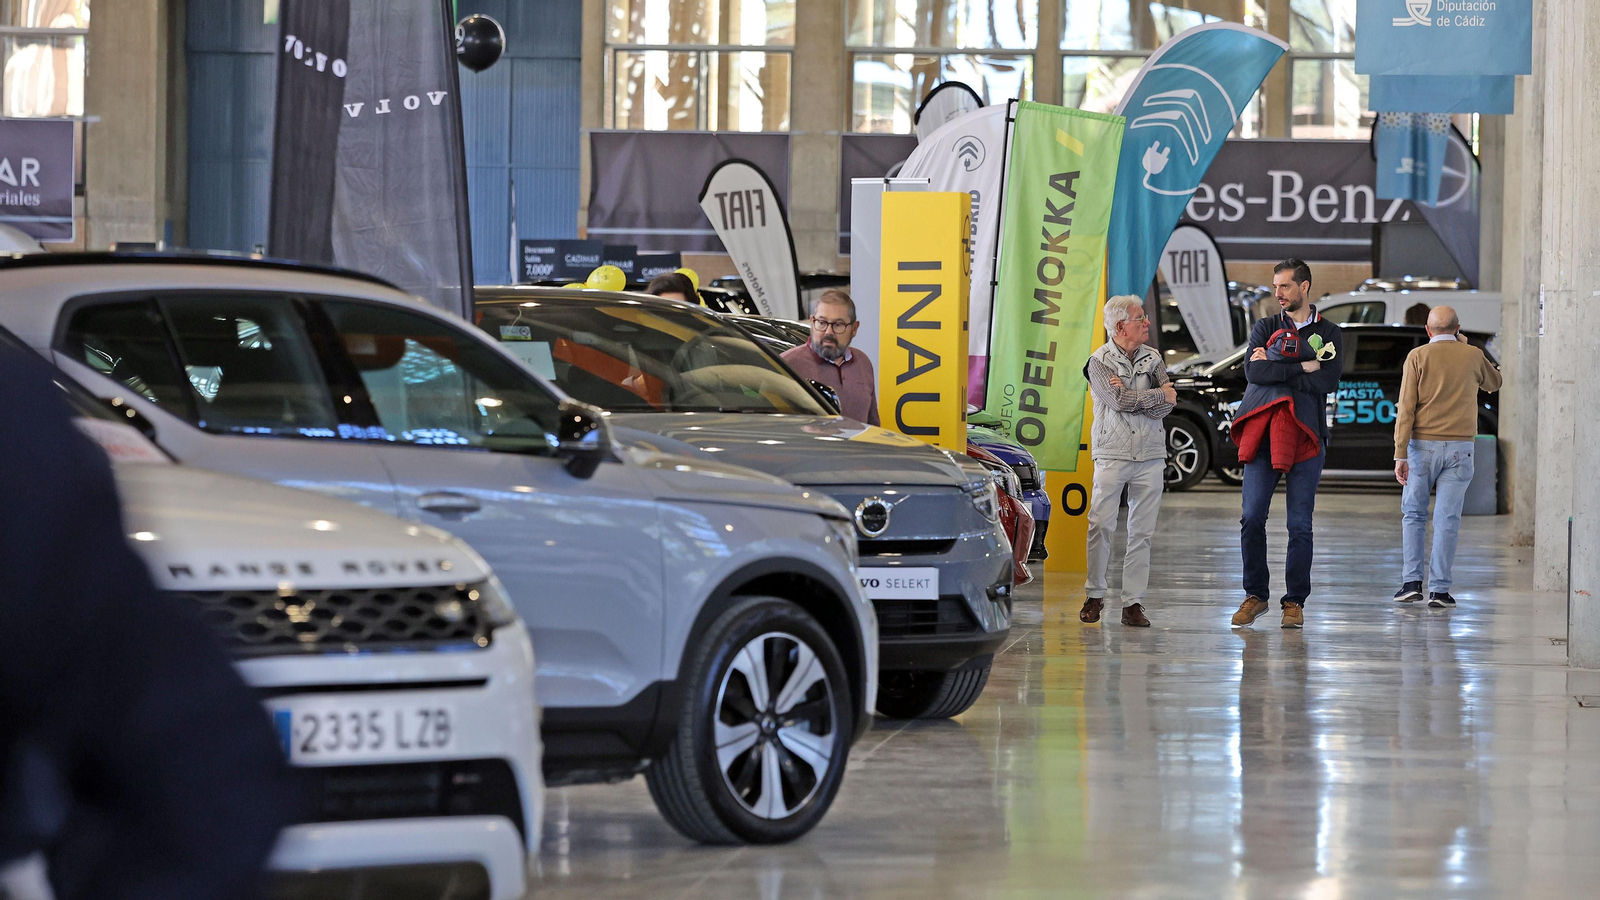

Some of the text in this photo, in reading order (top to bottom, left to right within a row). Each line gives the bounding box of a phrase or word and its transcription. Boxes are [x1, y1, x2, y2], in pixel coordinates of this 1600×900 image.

[1436, 0, 1496, 12] Diputación
[1436, 15, 1485, 26] de Cádiz
[1015, 170, 1081, 447] OPEL MOKKA
[895, 260, 942, 448] INAU
[1336, 389, 1385, 400] HASTA
[1001, 383, 1015, 438] UEVO
[1336, 400, 1396, 424] 550
[885, 578, 930, 589] SELEKT
[300, 709, 452, 752] 2335 LZB
